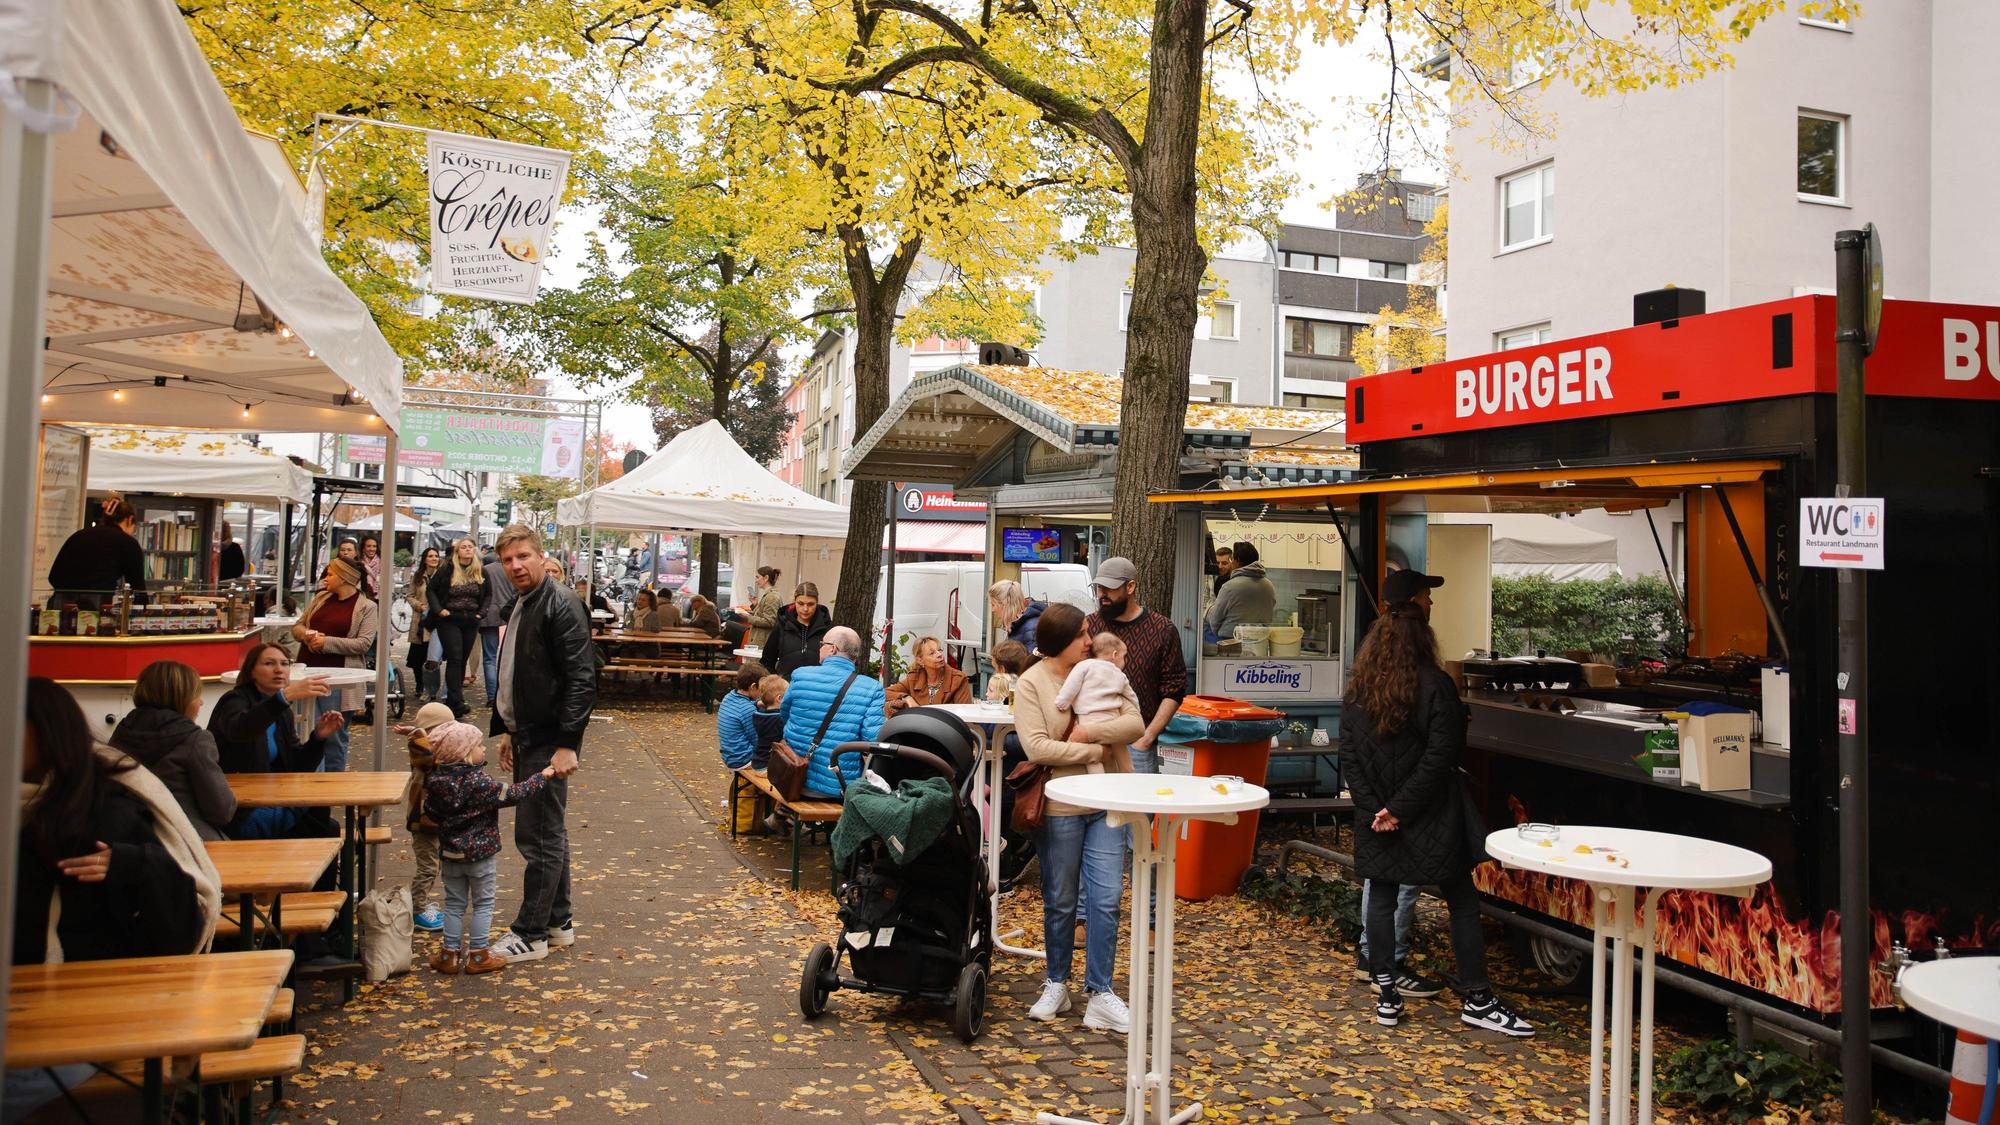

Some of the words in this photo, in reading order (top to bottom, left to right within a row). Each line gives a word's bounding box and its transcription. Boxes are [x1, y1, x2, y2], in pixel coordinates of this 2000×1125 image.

[440, 151, 552, 180] KÖSTLICHE
[433, 169, 554, 249] Crêpes
[451, 253, 505, 264] FRUCHTIG,
[452, 264, 512, 276] HERZHAFT,
[454, 274, 524, 288] BESCHWIPST!
[1456, 346, 1614, 419] BURGER
[1807, 505, 1849, 536] WC
[1806, 539, 1840, 548] Restaurant
[1842, 541, 1878, 549] Landmann
[1235, 669, 1301, 688] Kibbeling
